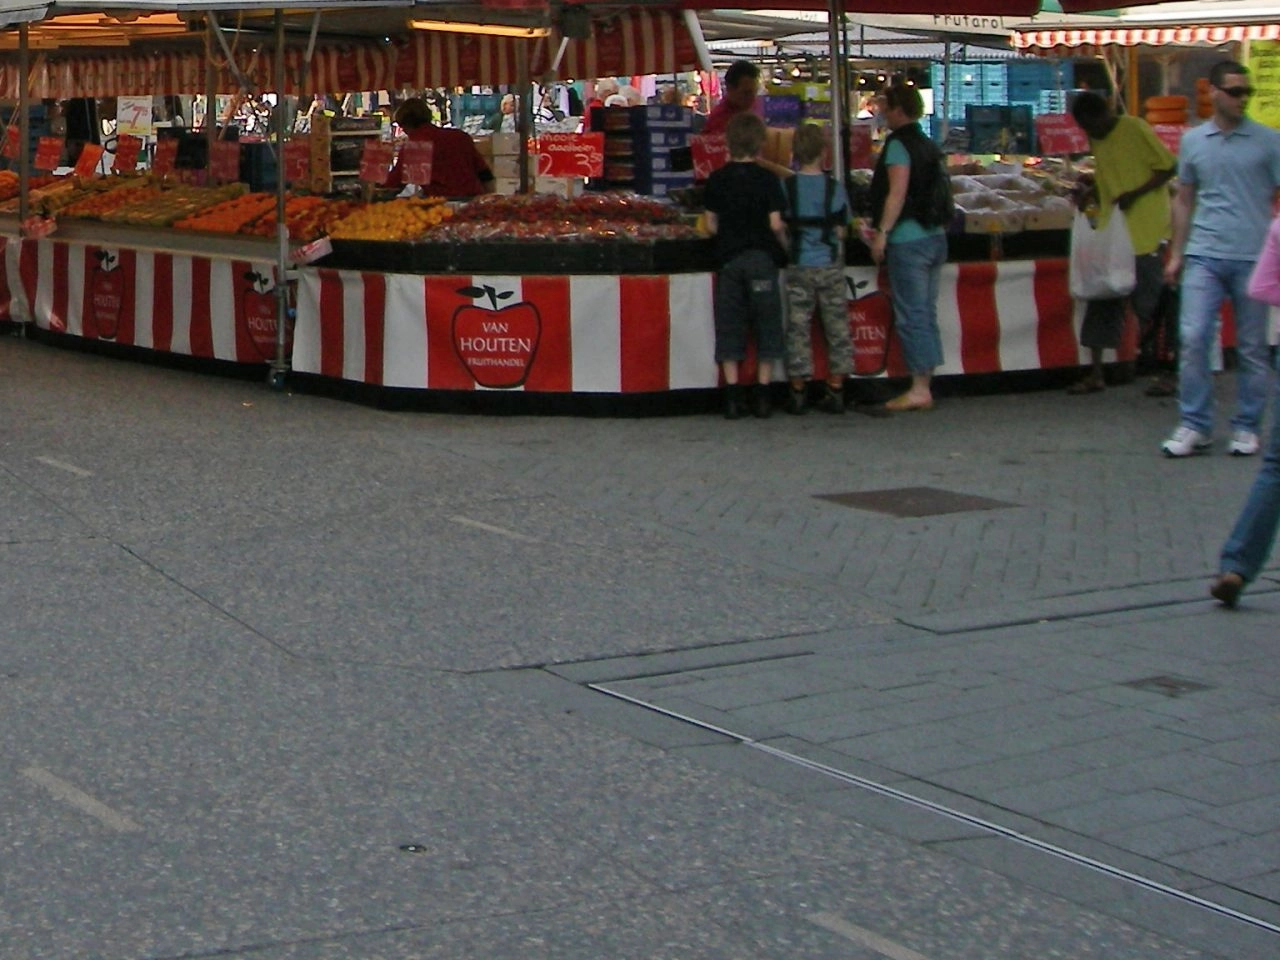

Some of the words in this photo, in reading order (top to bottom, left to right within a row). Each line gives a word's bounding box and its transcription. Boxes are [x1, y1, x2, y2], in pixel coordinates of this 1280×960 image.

[482, 322, 509, 333] VAN
[460, 337, 531, 353] HOUTEN
[467, 357, 524, 368] FRUITHANDEL
